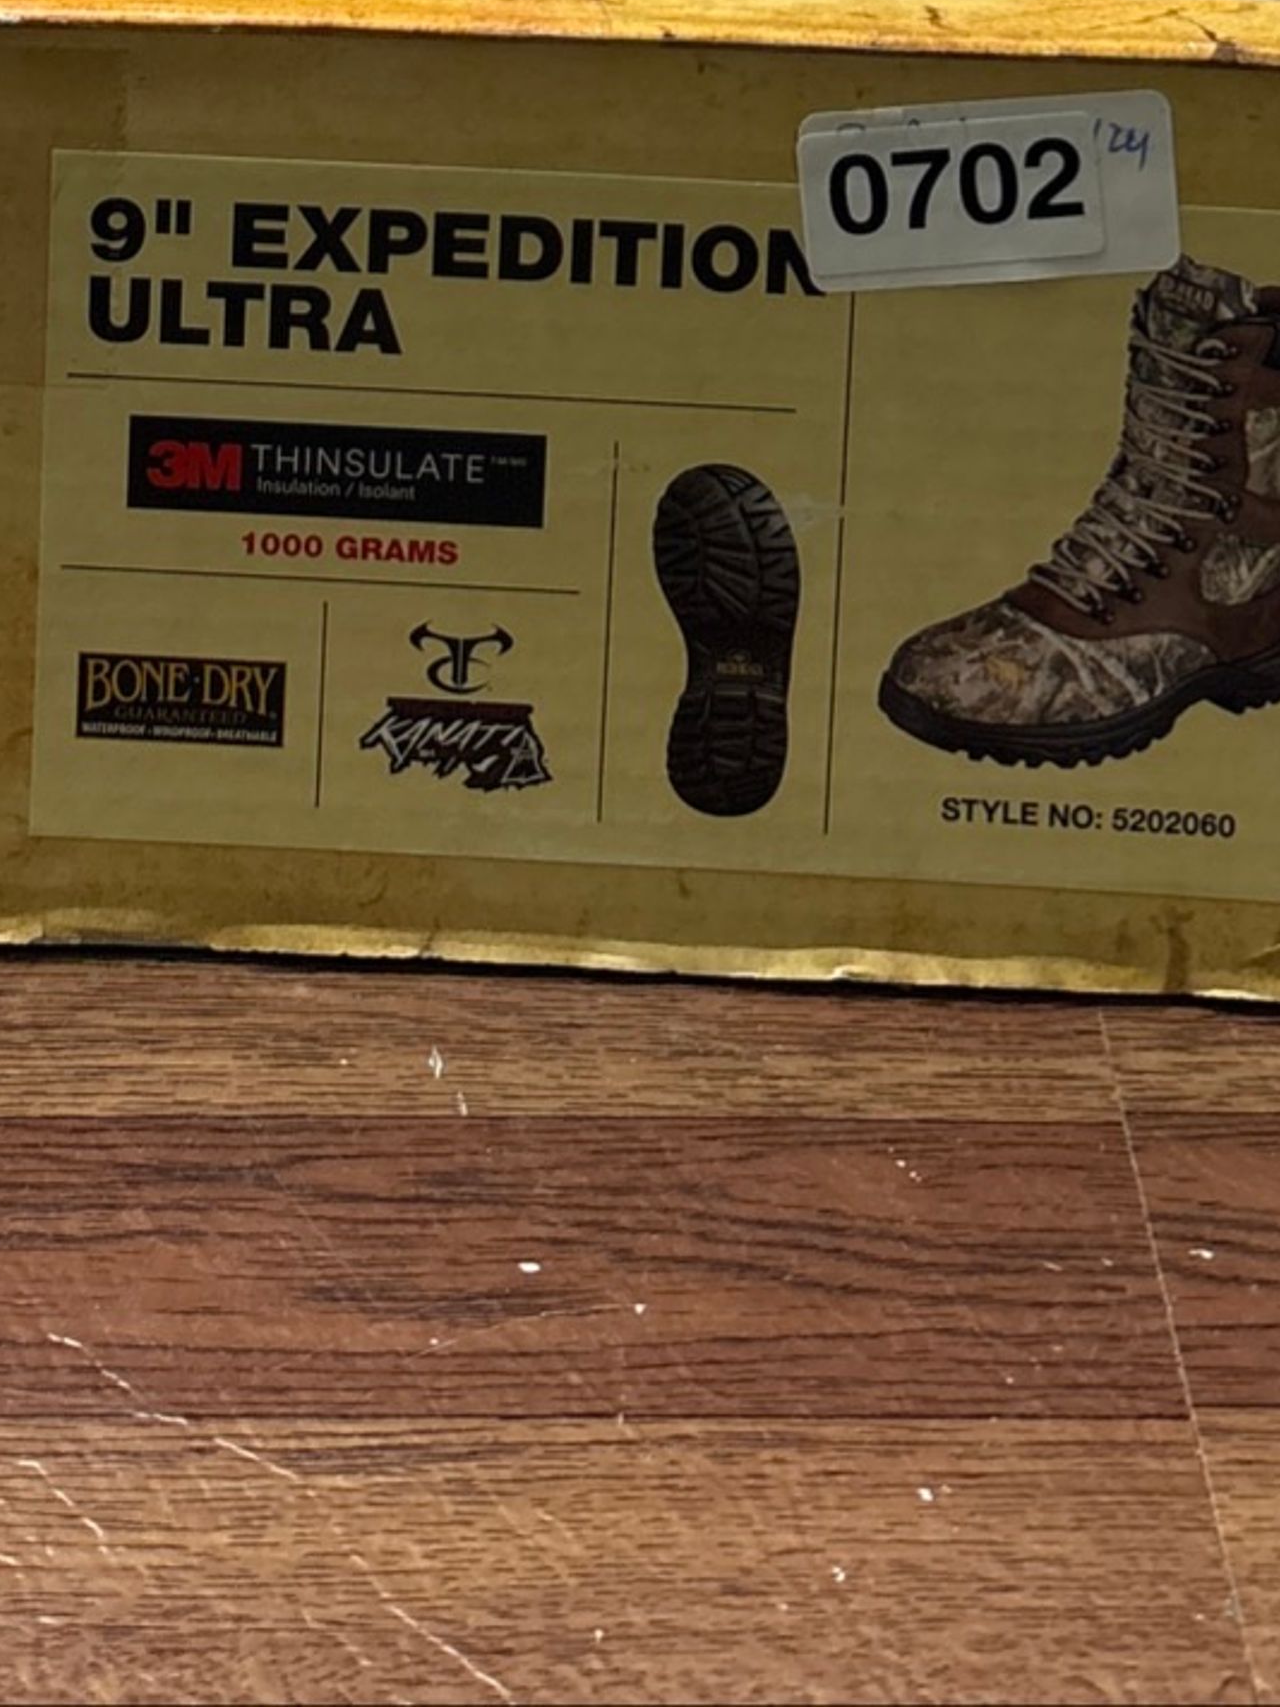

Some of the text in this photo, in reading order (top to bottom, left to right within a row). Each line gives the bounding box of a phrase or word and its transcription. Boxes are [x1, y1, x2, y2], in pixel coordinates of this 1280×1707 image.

[828, 137, 1087, 235] 0702
[89, 197, 828, 297] 9" EXPEDITION
[87, 275, 404, 355] ULTRA
[145, 438, 488, 492] 3M THINSULATE
[255, 477, 342, 500] Insulation
[358, 481, 417, 503] Isolant
[241, 531, 459, 566] 1000 GRAMS
[112, 704, 249, 725] GUARANTEED
[941, 797, 1237, 839] STYLE NO: 5202060
